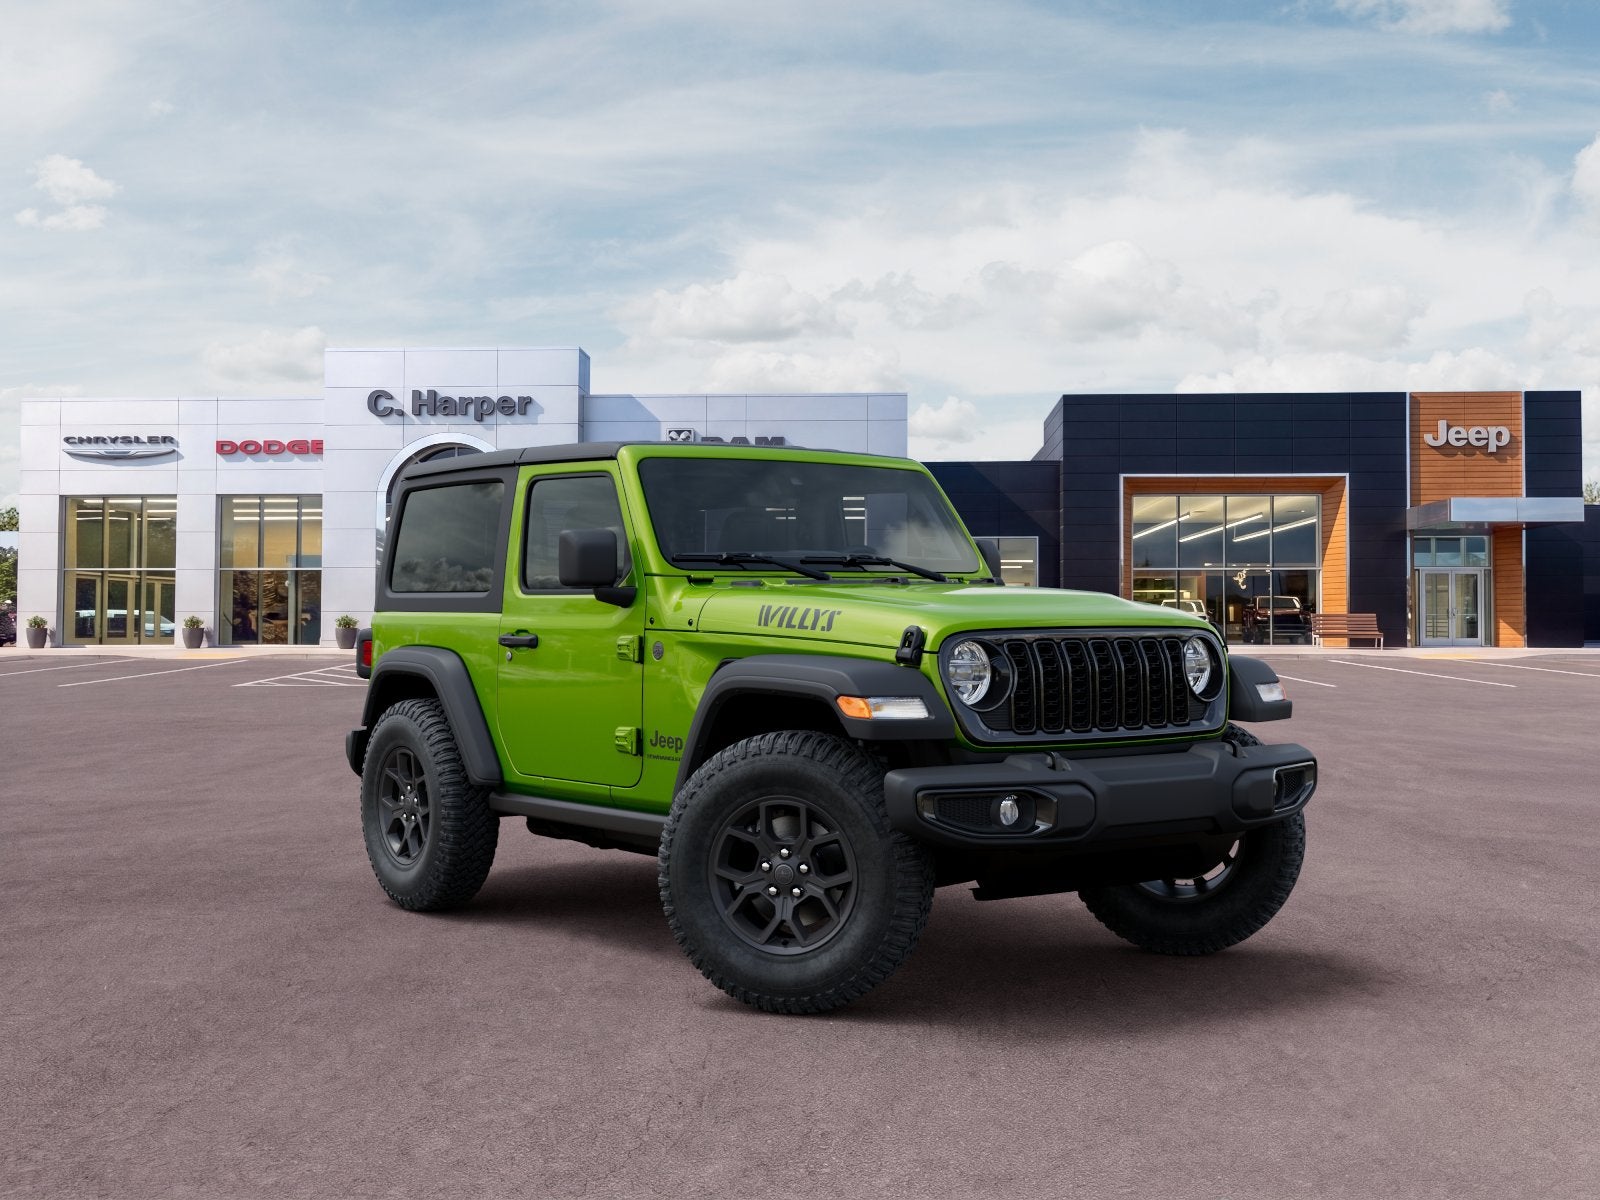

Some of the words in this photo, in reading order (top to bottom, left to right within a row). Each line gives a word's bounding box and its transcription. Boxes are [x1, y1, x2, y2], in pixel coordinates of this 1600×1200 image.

[367, 389, 404, 417] C.
[412, 389, 532, 422] Harper
[63, 435, 177, 446] CHRYSLER
[216, 440, 324, 455] DODGE
[1423, 419, 1511, 453] Jeep
[757, 604, 842, 632] WILLYS
[649, 729, 684, 753] Jeep
